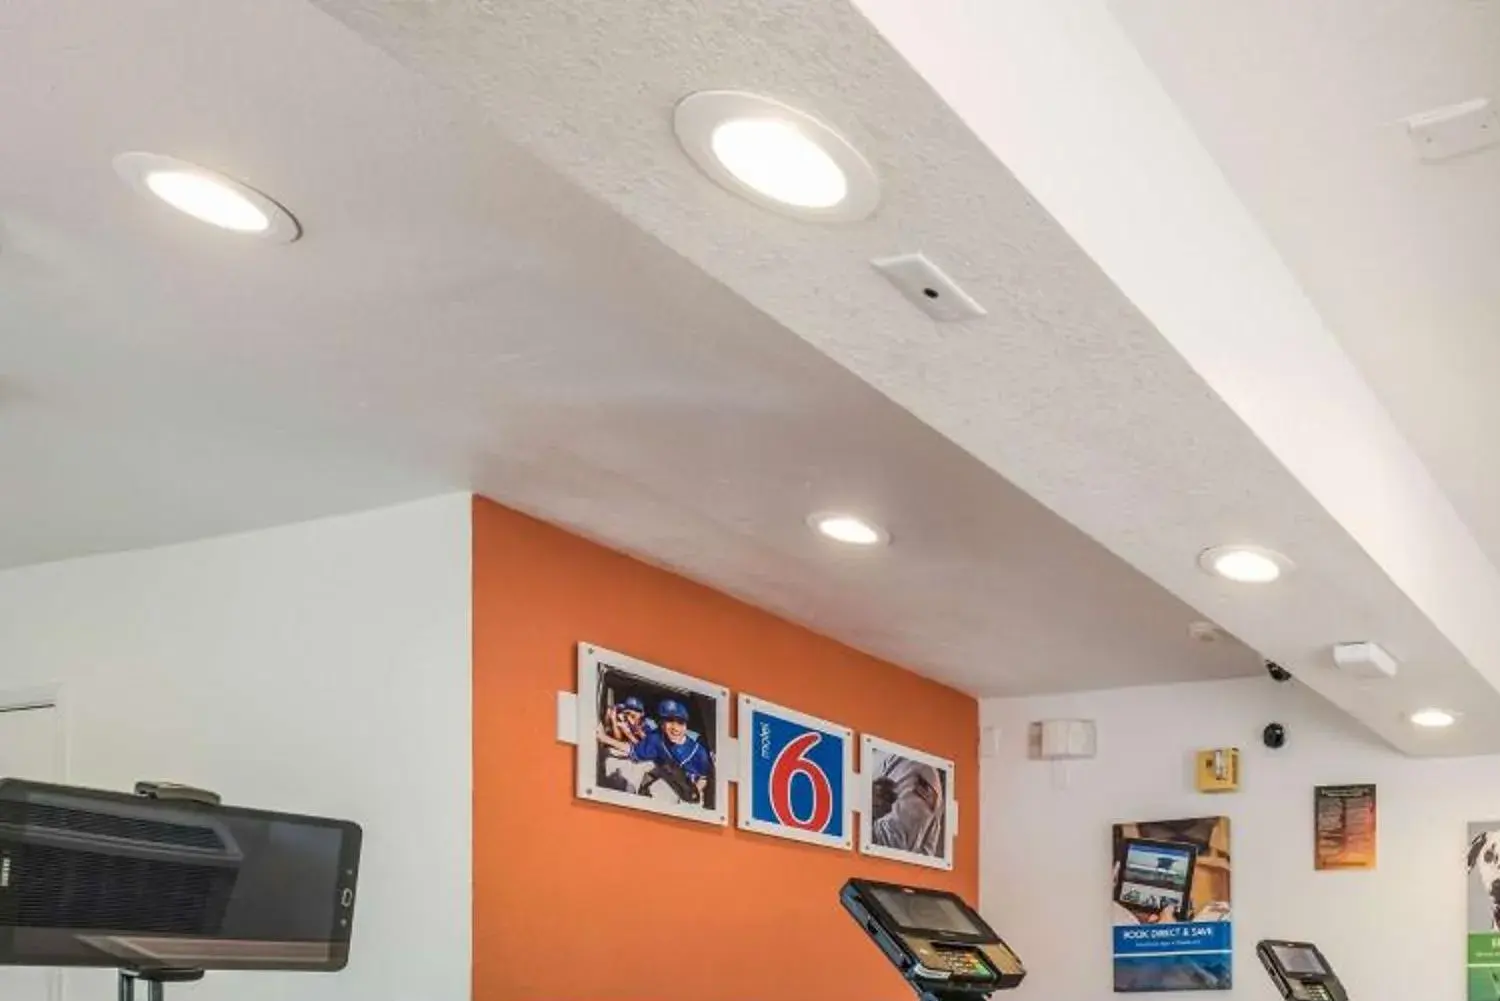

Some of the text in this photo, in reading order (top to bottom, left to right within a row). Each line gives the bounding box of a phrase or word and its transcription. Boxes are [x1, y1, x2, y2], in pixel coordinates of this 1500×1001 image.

[759, 722, 834, 833] motel 6
[1151, 928, 1180, 939] DIRECT
